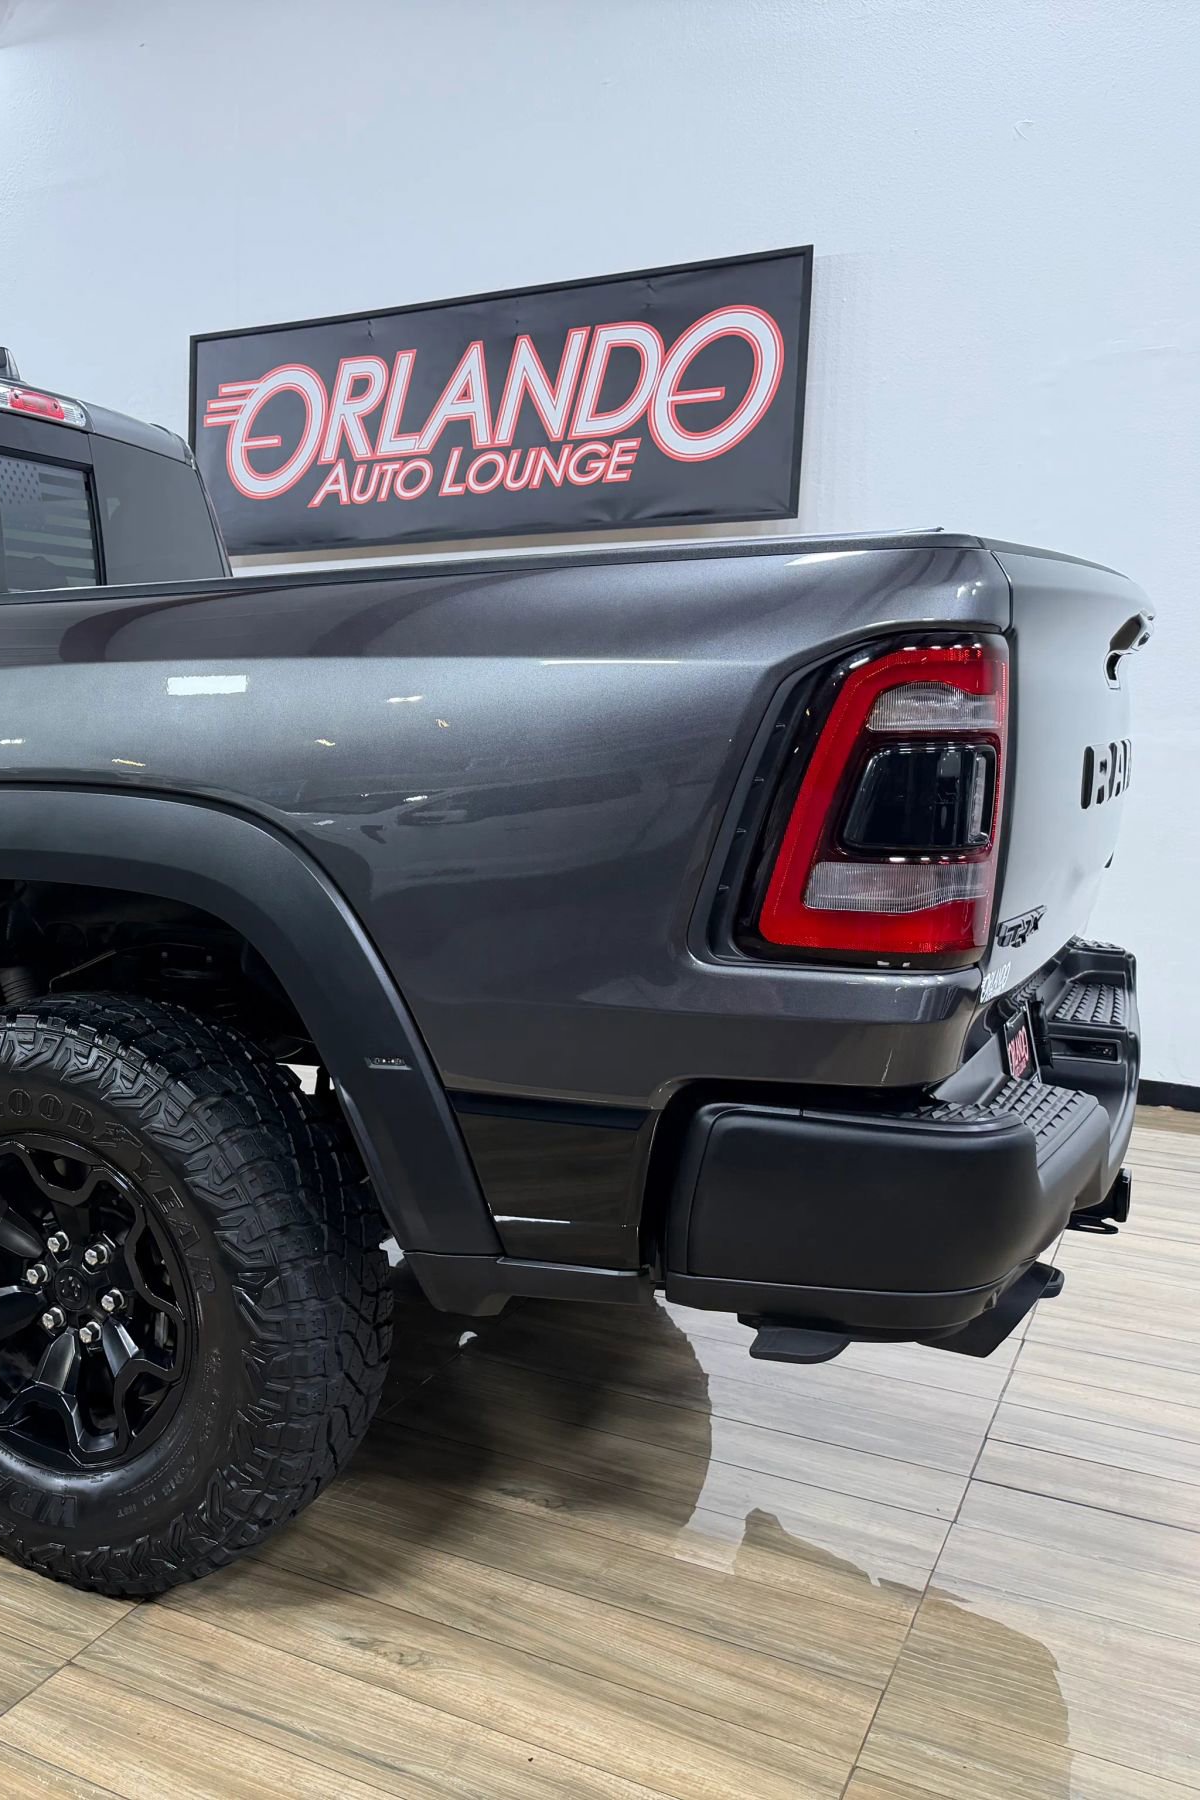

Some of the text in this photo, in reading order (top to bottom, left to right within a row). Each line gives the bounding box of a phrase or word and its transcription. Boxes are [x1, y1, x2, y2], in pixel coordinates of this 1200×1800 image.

[204, 303, 785, 500] ORLANDO
[307, 438, 643, 508] AUTO LOUNGE
